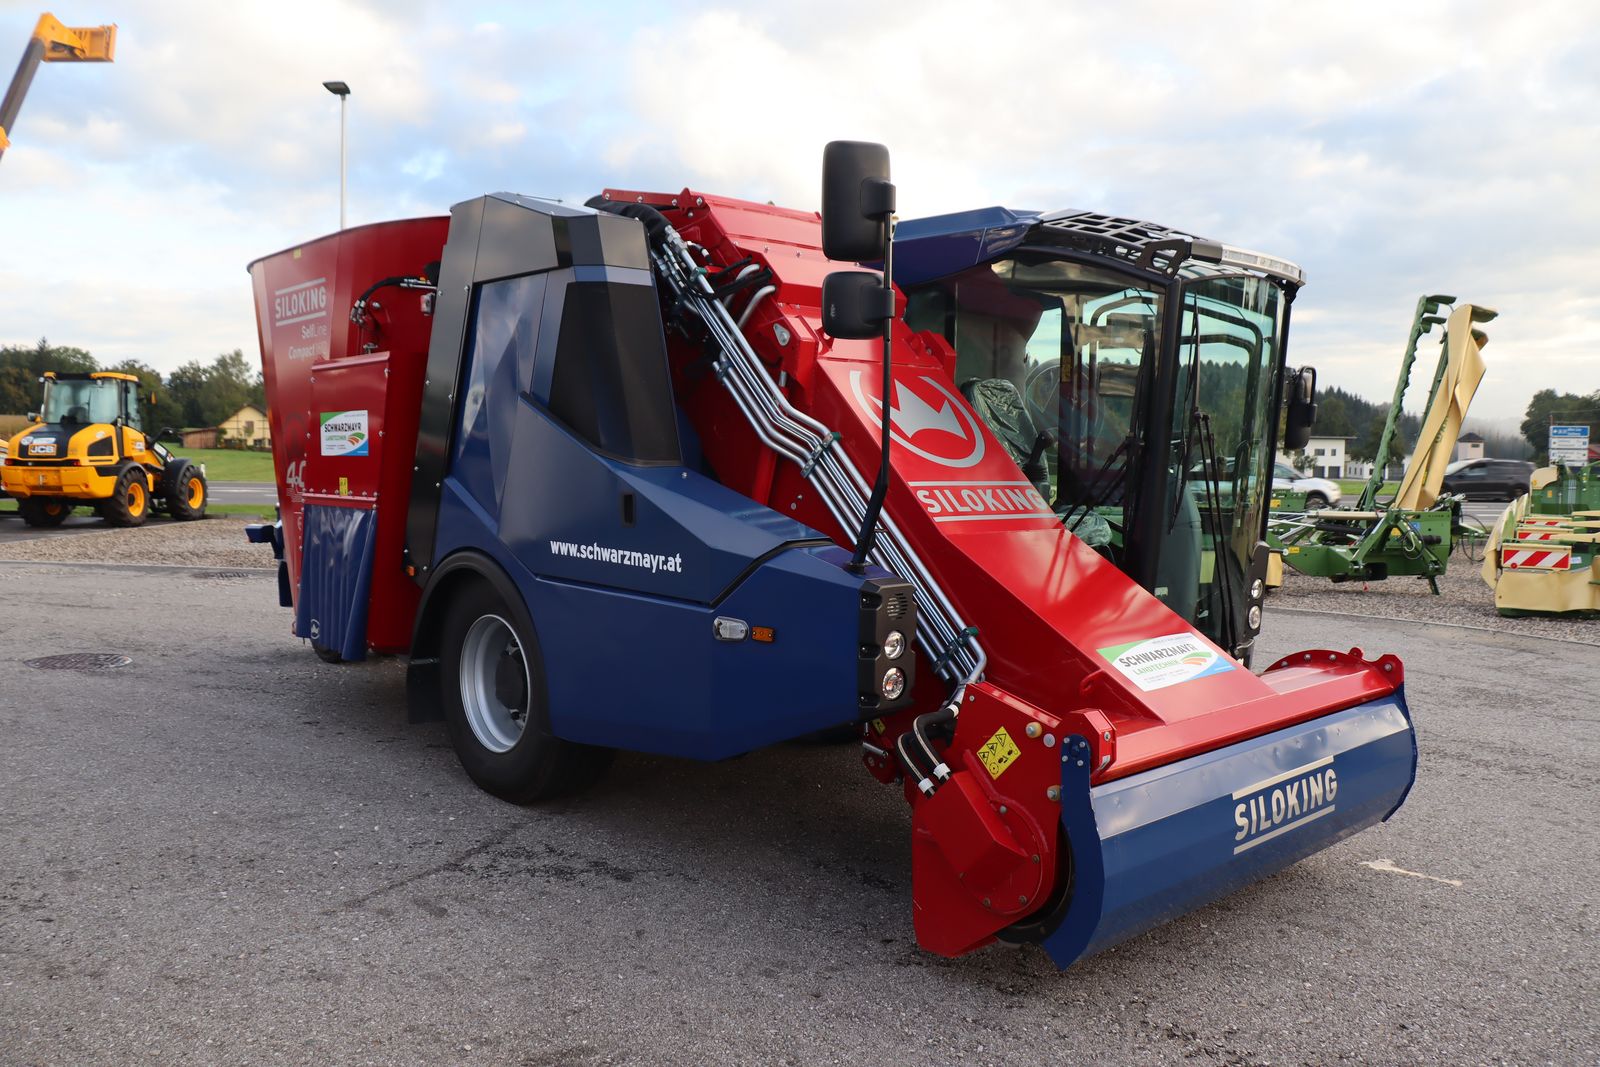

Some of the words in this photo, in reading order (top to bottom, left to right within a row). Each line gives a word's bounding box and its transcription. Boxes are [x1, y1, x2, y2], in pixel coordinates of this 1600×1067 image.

[275, 286, 327, 319] SILOKING
[324, 421, 362, 432] SCHWARZMAYR
[30, 445, 55, 453] JCB
[916, 489, 1048, 513] SILOKING
[549, 540, 682, 573] www.schwarzmayr.at
[1118, 643, 1198, 668] SCHWARZMAYR
[1234, 768, 1338, 841] SILOKING
